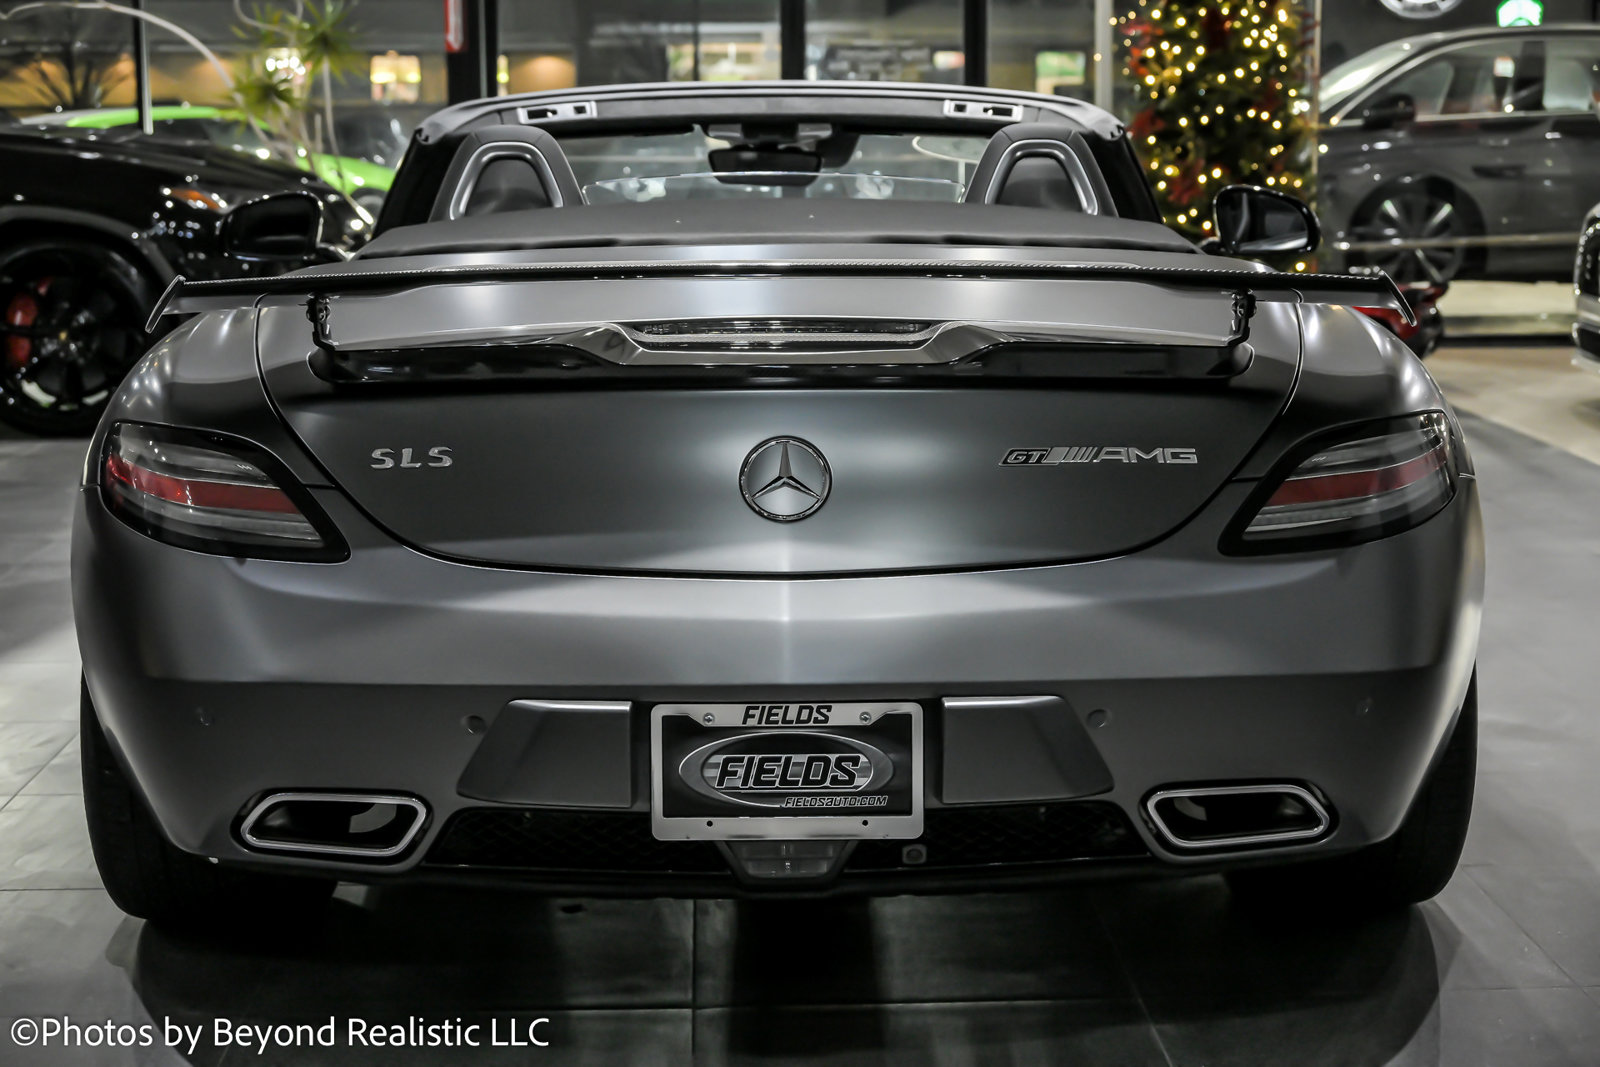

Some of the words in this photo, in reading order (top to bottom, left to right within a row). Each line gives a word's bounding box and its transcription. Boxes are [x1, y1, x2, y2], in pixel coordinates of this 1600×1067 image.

[370, 446, 453, 469] SLS
[1007, 450, 1047, 464] GT
[1093, 446, 1198, 464] AMG
[742, 704, 832, 725] FIELDS
[715, 754, 861, 789] FIELDS
